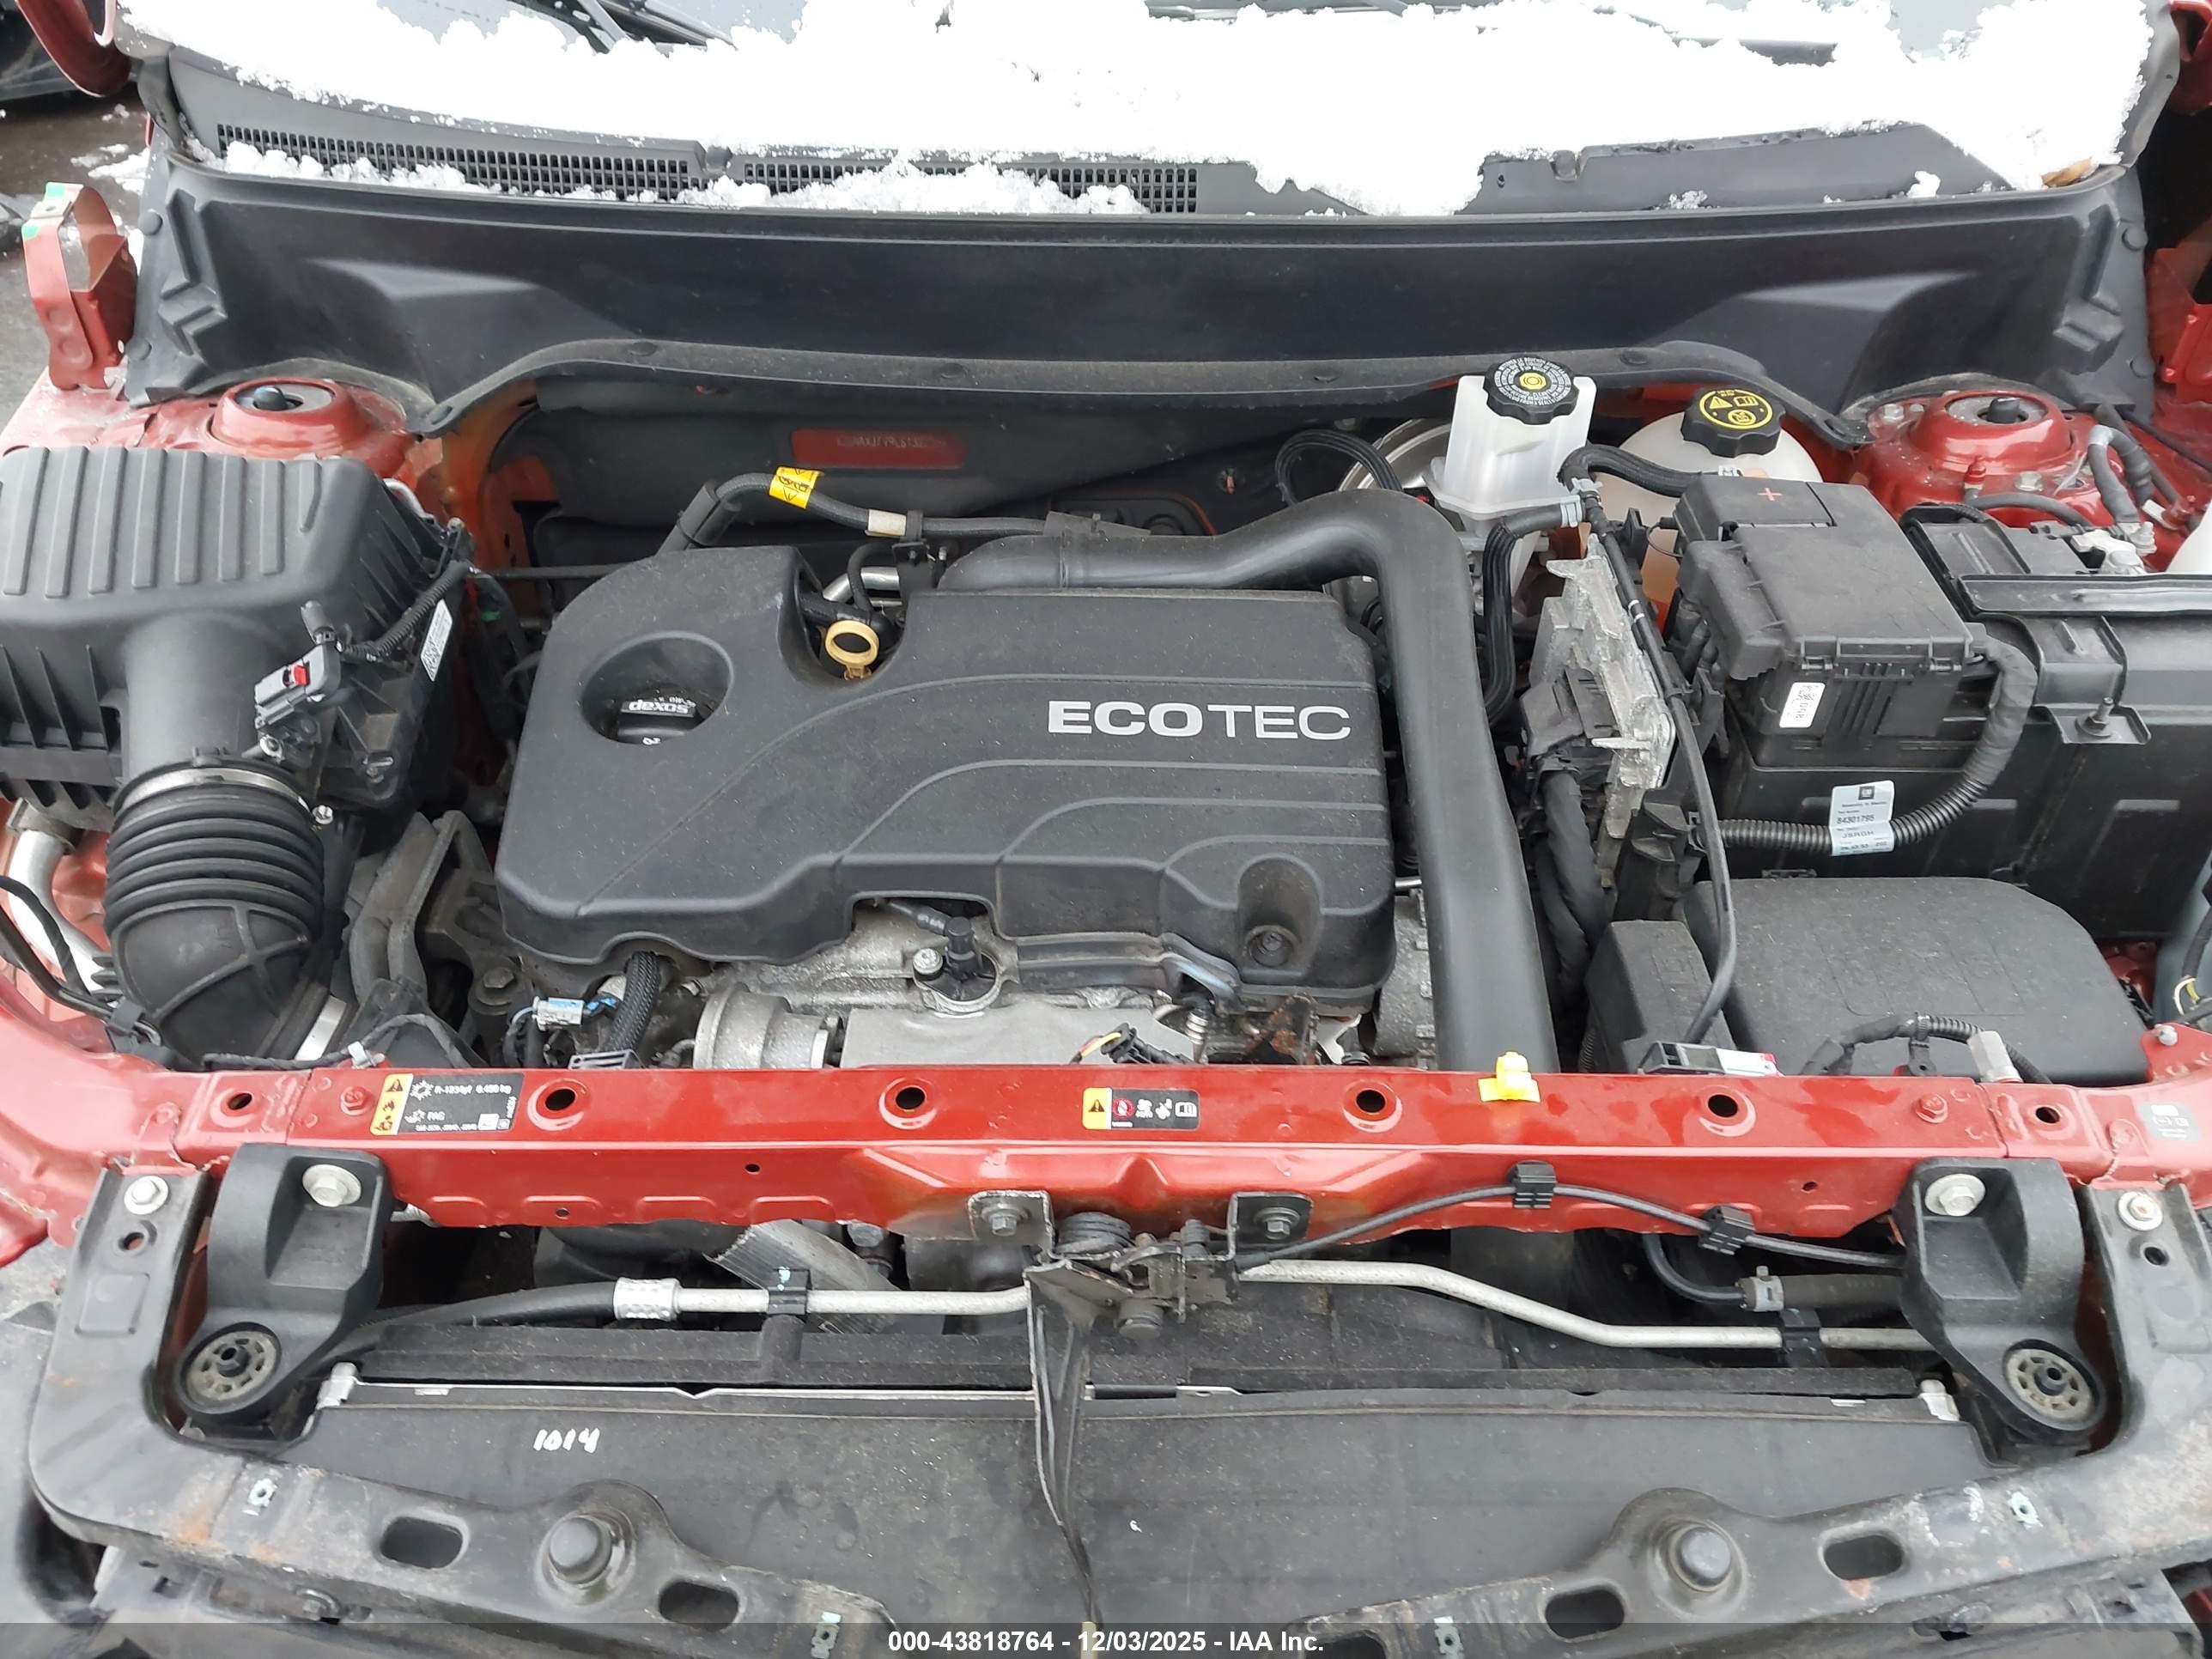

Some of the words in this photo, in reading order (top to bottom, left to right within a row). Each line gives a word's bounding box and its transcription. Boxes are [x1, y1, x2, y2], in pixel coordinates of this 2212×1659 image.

[629, 699, 689, 714] dexos
[1048, 701, 1351, 740] ECOTEC
[533, 1428, 600, 1454] 1014
